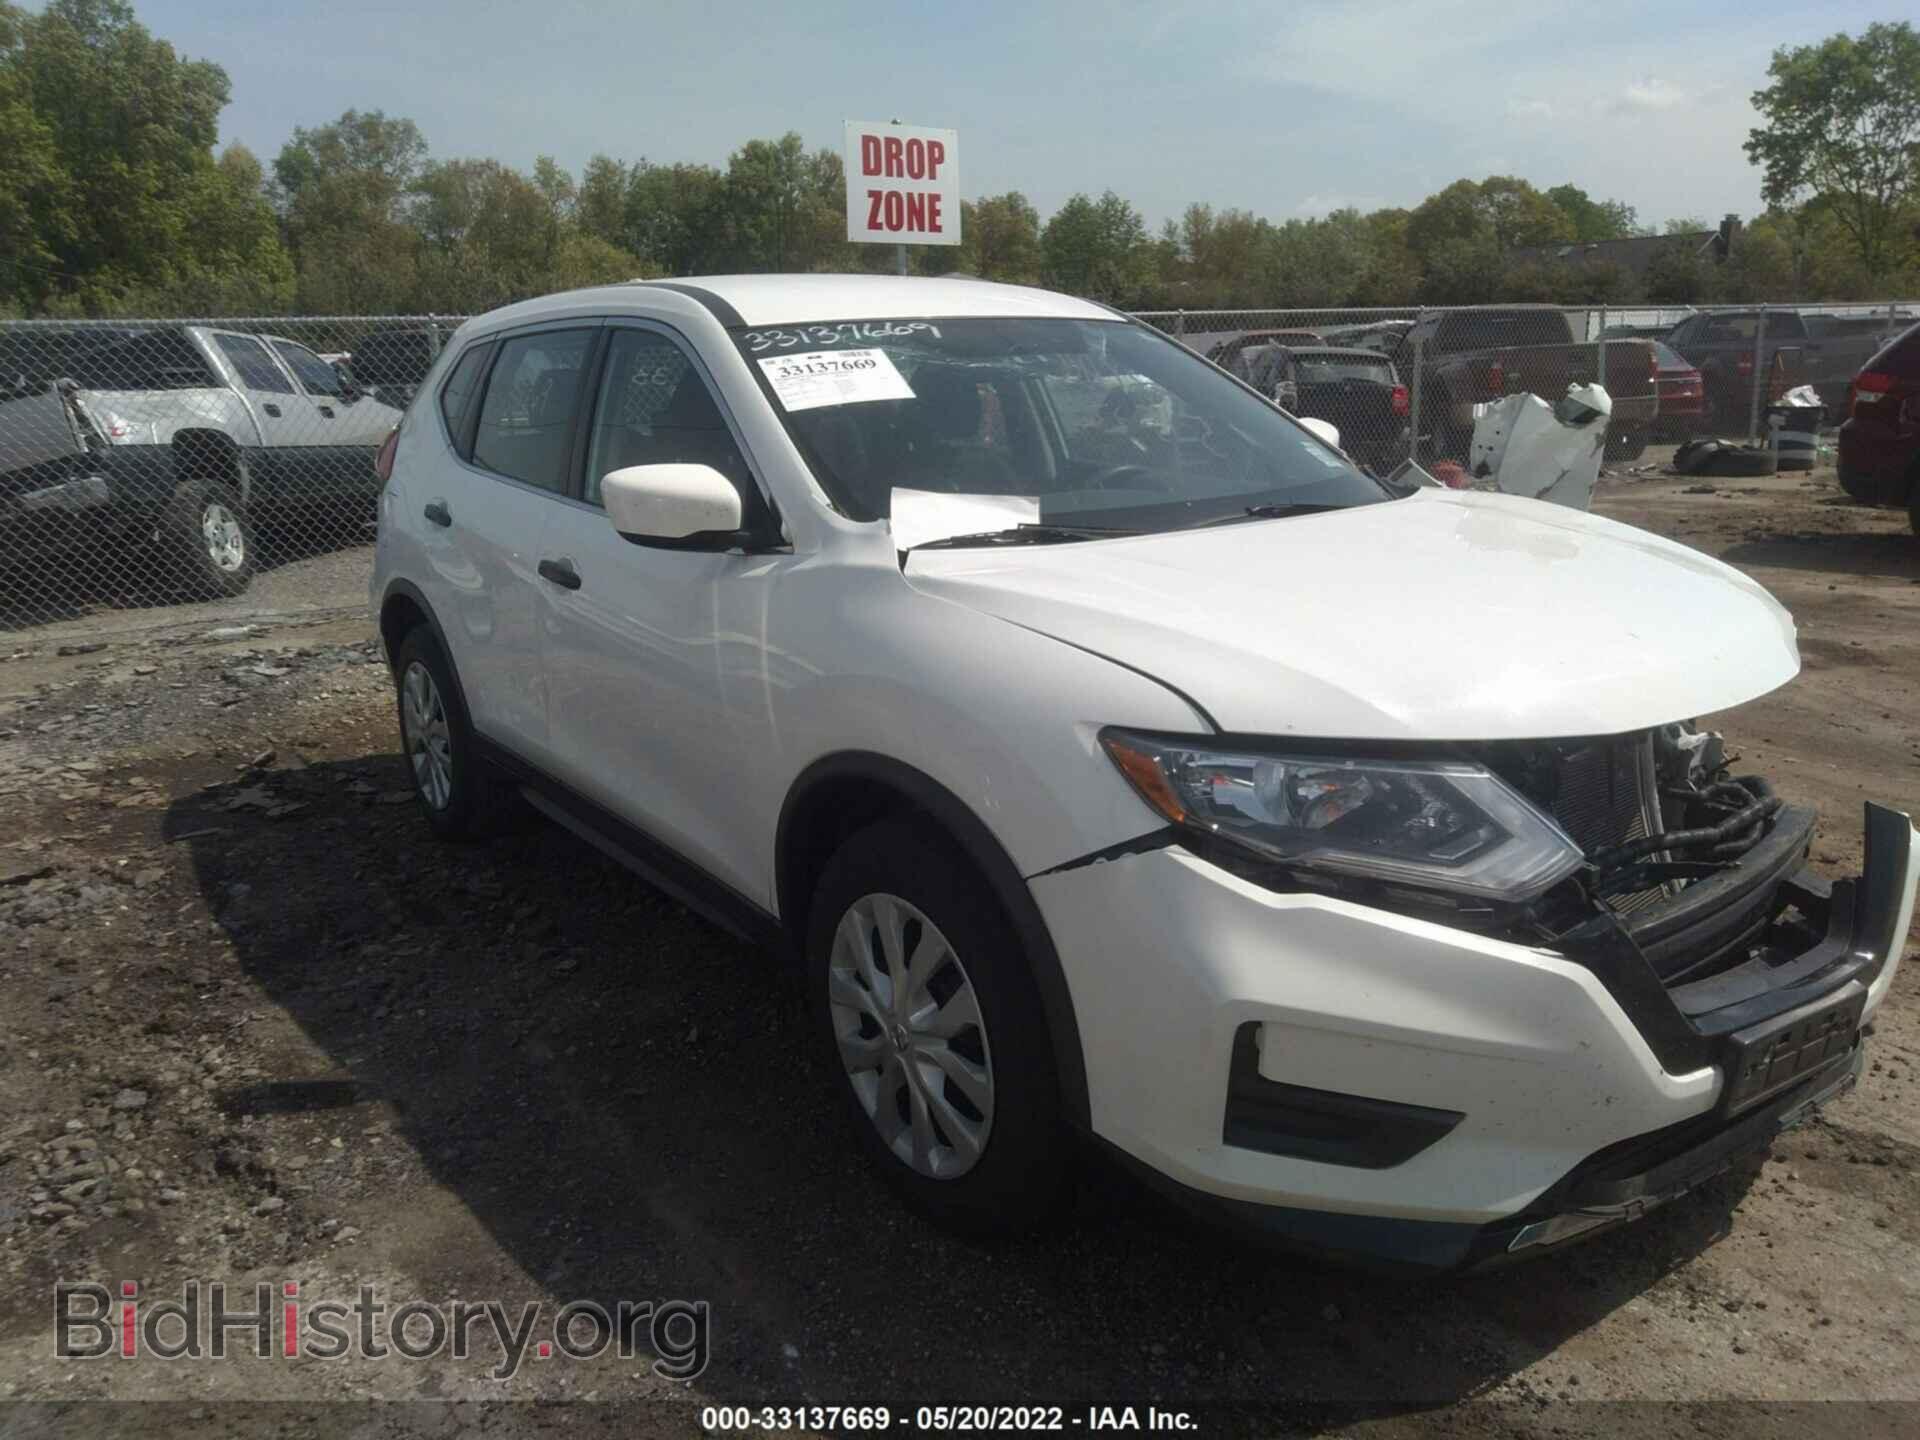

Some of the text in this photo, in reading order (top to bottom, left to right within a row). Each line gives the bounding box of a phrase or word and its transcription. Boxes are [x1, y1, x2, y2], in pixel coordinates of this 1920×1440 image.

[861, 134, 945, 180] DROP
[867, 189, 943, 233] ZONE
[745, 322, 942, 351] 33137669
[778, 359, 877, 379] 33137669
